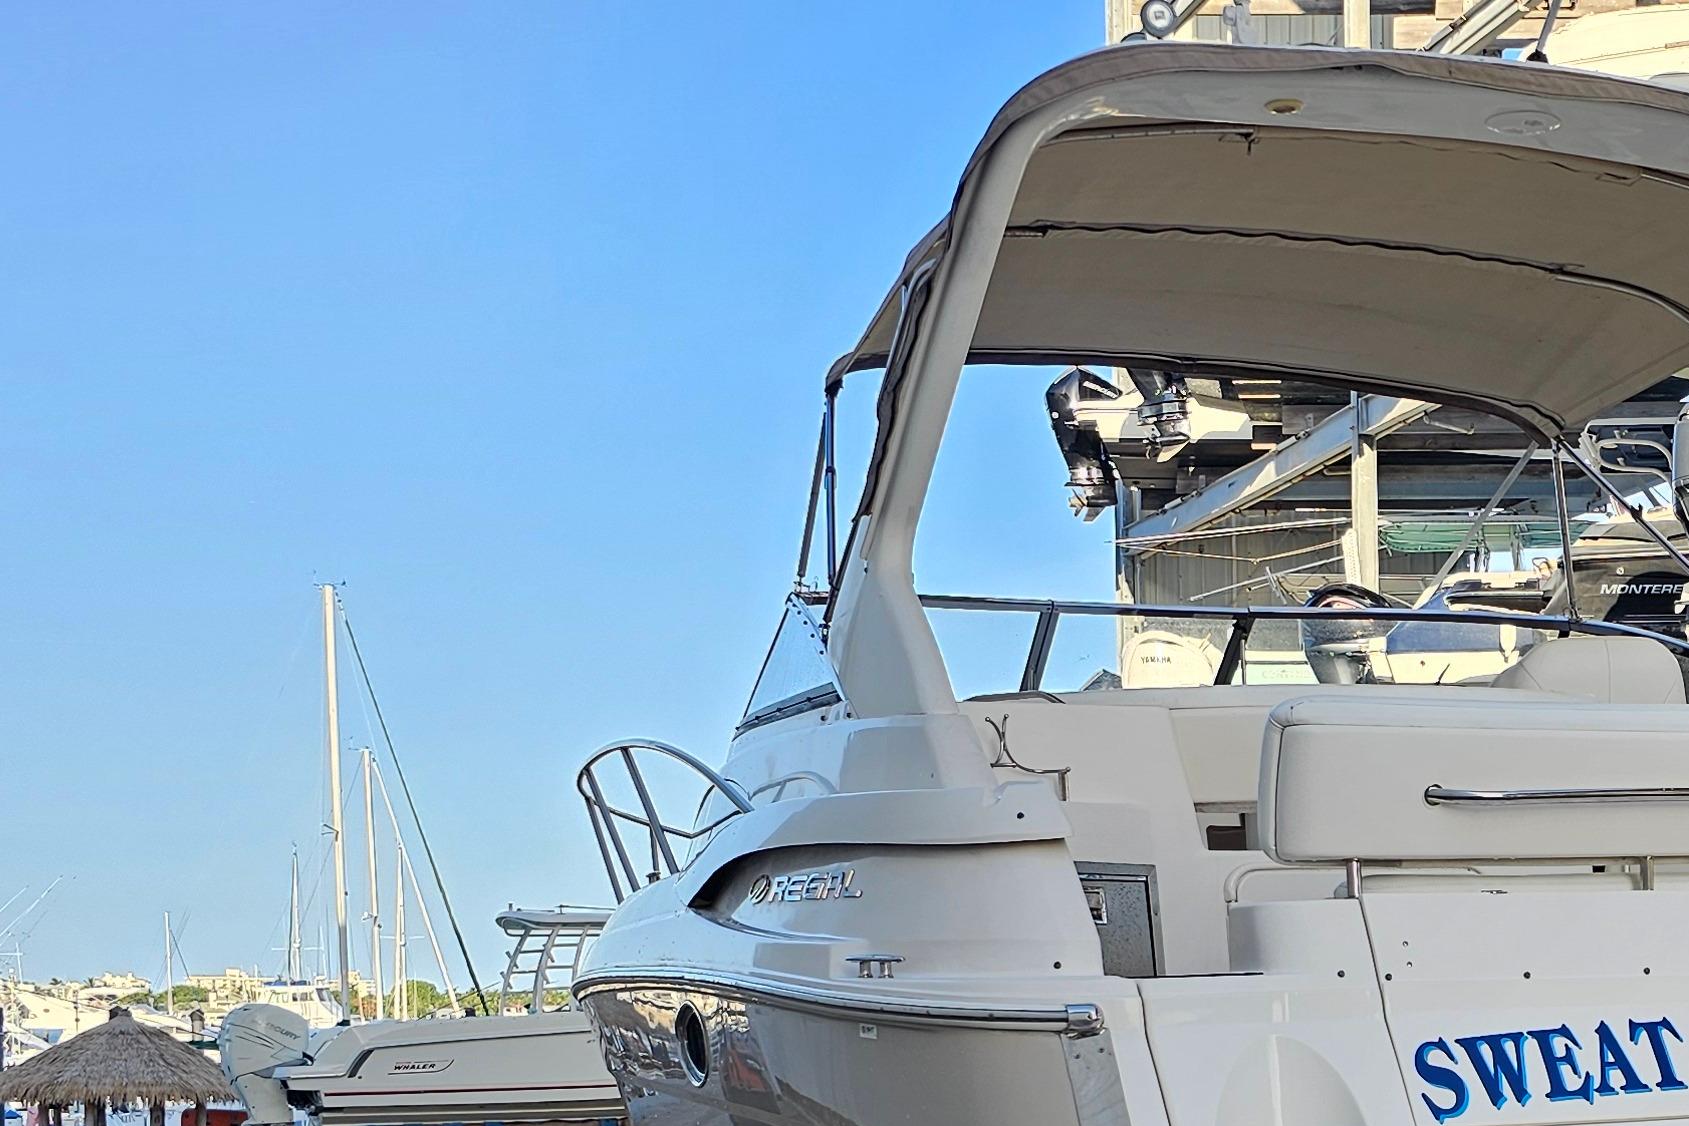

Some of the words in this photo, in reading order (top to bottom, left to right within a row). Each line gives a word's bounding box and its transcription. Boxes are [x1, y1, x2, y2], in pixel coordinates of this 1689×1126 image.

[1600, 583, 1684, 595] MONTERE
[768, 869, 863, 903] REGAL
[394, 1063, 436, 1071] WHALER
[1413, 1016, 1688, 1124] SWEAT
